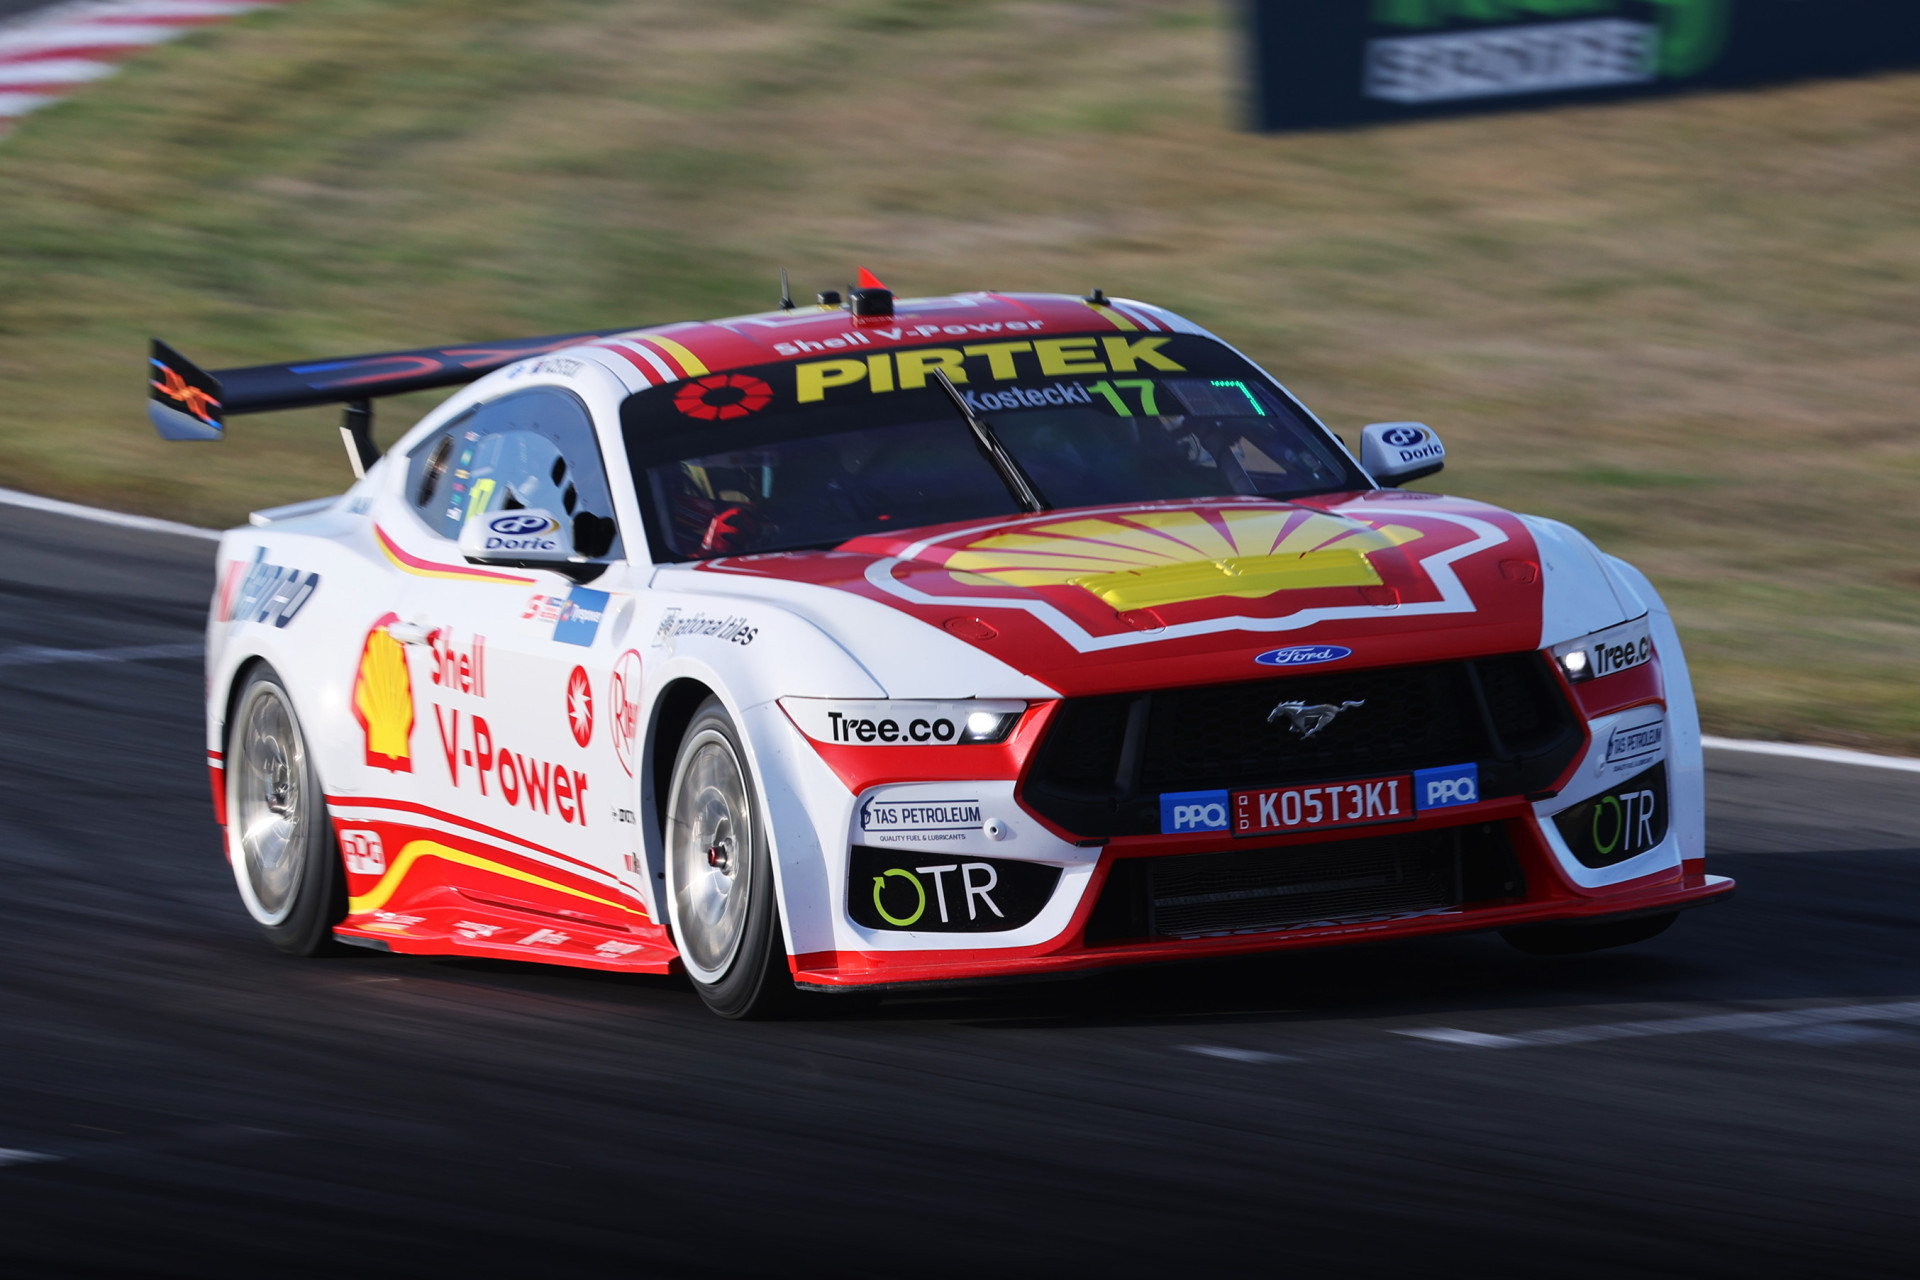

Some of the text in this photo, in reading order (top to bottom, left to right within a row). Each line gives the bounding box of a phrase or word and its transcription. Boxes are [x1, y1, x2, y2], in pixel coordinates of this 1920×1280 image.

[772, 317, 1044, 356] Shell V-Power
[796, 336, 1188, 404] PIRTEK
[960, 379, 1160, 417] Kostecki 17
[1399, 443, 1443, 463] Doric
[485, 536, 556, 550] Doric
[430, 625, 487, 699] Shell
[1275, 647, 1333, 664] Ford
[828, 712, 955, 742] Tree.co
[432, 702, 589, 828] V-Power
[1427, 776, 1476, 805] PPQ
[873, 806, 981, 824] TAS PETROLEUM
[1174, 802, 1227, 830] PPQ
[1593, 789, 1654, 854] OTR
[879, 834, 905, 842] QUALITY
[928, 833, 966, 841] LUBRICANTS
[872, 862, 1005, 926] OTR
